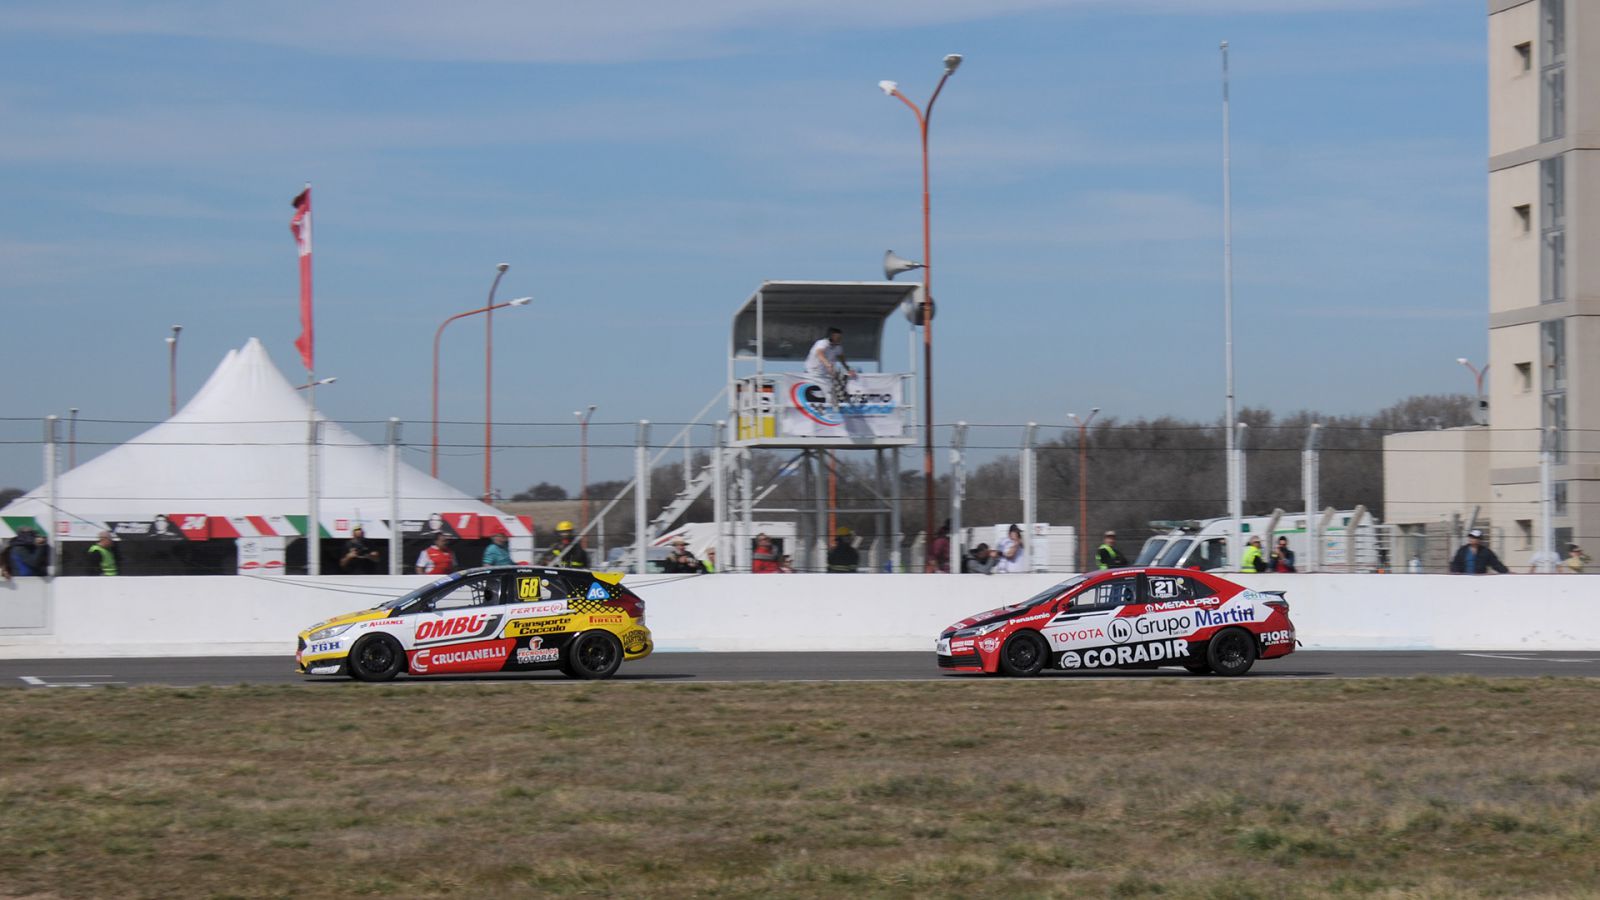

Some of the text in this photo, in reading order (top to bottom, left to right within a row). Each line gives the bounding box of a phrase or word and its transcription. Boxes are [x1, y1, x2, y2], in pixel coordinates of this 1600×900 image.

[519, 579, 539, 598] 68
[588, 588, 605, 599] AG
[1154, 580, 1173, 594] 21
[511, 605, 549, 614] FERTEC
[1155, 597, 1220, 611] METALPRO
[513, 618, 571, 629] Transporte
[589, 615, 622, 623] PIRELLI
[1010, 612, 1050, 625] Panasonic
[1135, 606, 1255, 636] Grupo Martin
[519, 625, 566, 635] Coccolo
[1052, 628, 1104, 643] TOYOTA
[312, 642, 340, 653] FGH
[1083, 639, 1190, 668] CORADIR
[432, 646, 506, 665] CRUCIANELLI
[518, 653, 558, 664] TOTORAS
